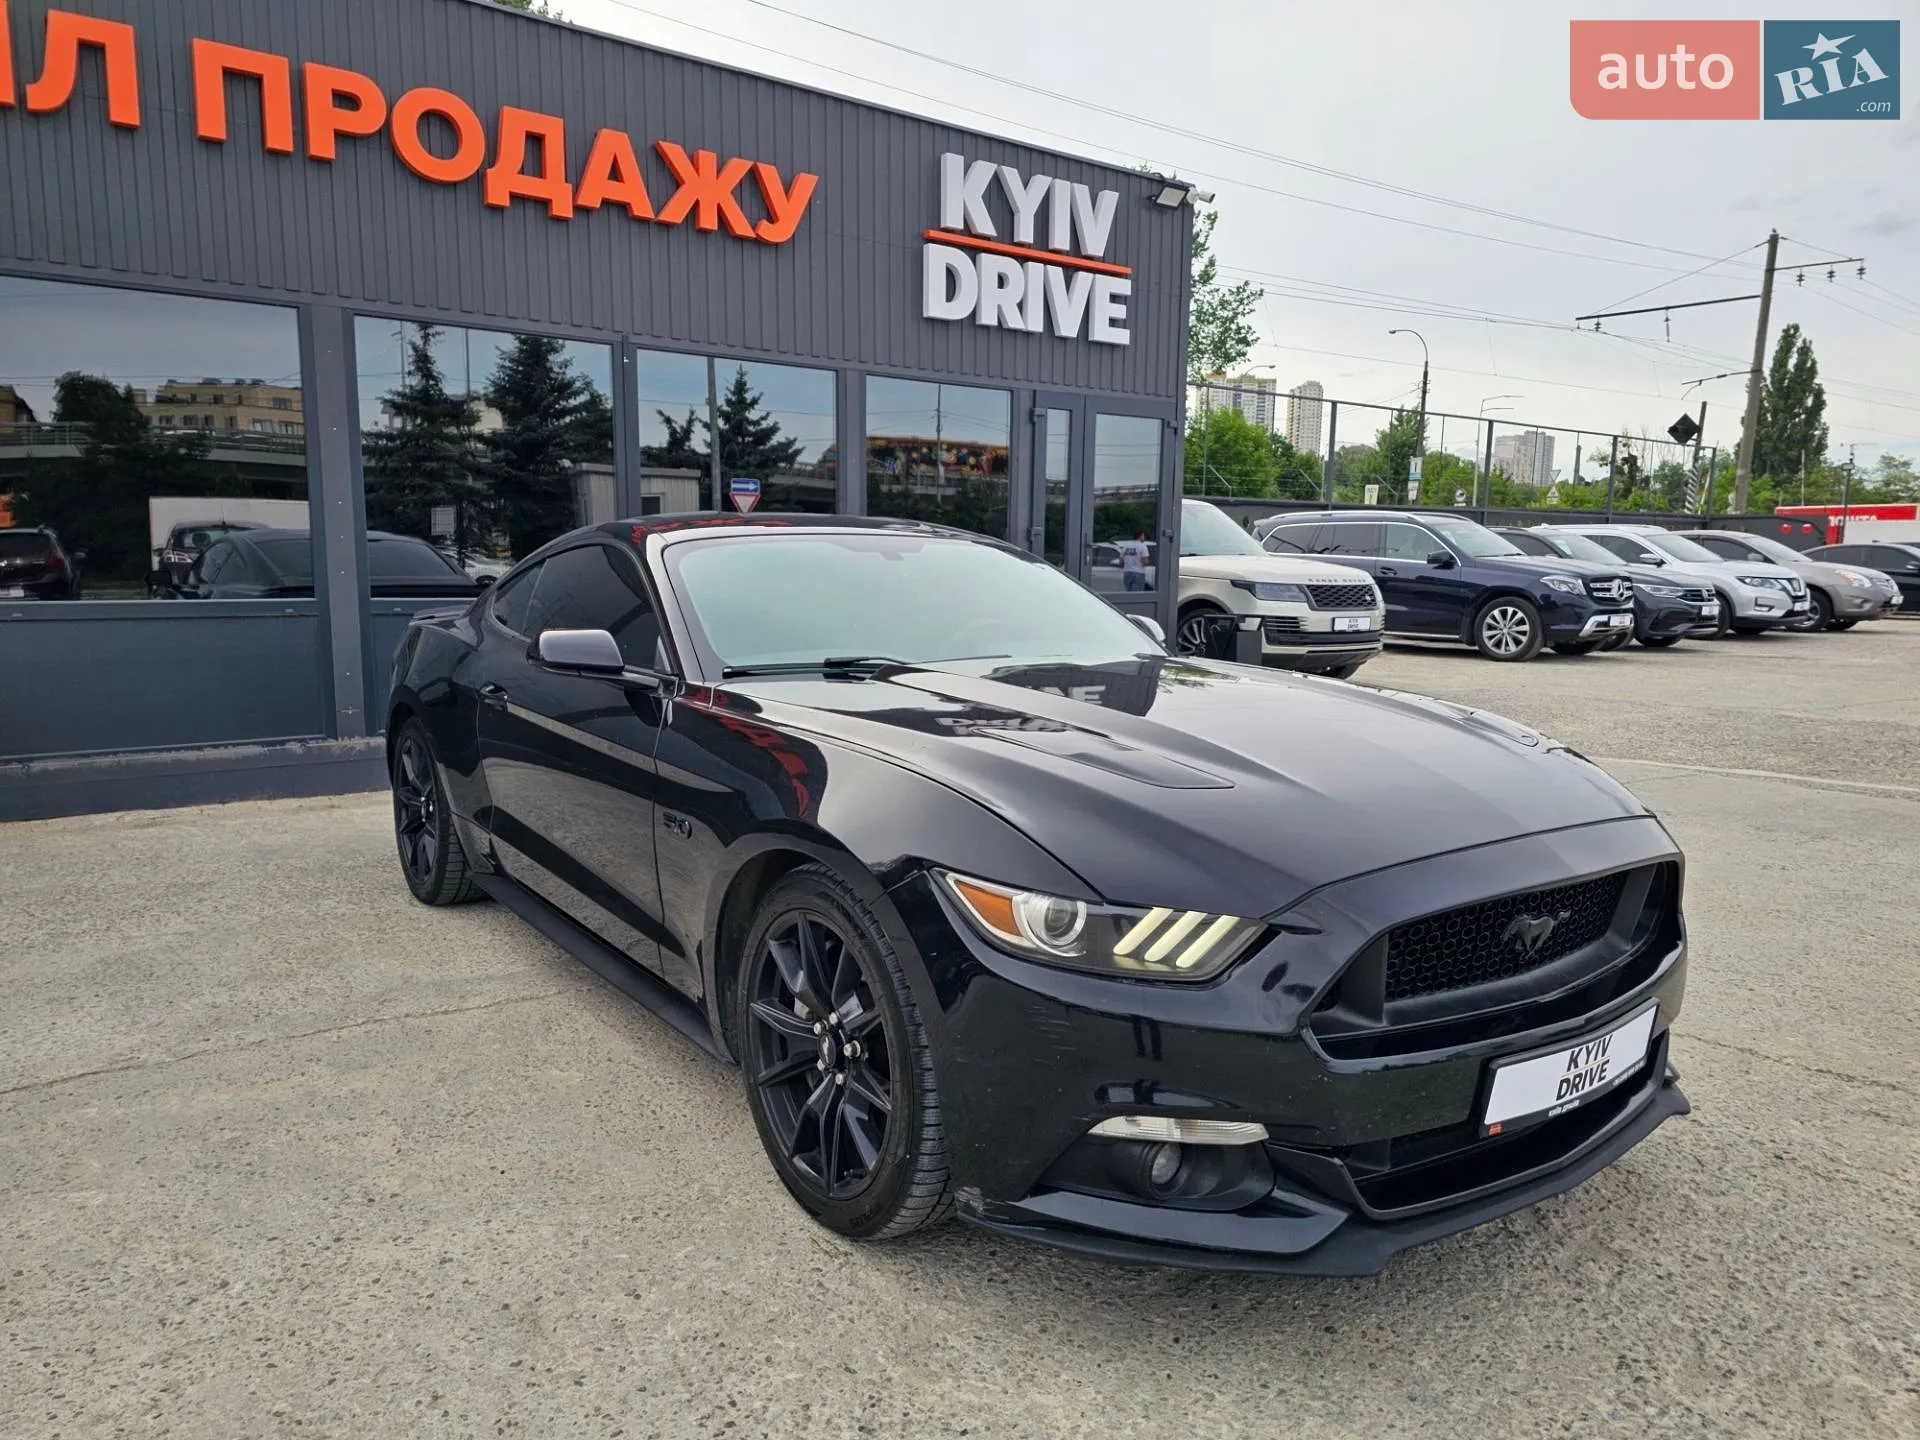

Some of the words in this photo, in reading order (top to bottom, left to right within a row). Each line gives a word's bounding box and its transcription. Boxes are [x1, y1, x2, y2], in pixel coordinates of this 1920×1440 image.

[192, 38, 818, 244] ПРОДАЖУ
[940, 152, 1119, 258] KYIV
[923, 243, 1131, 345] DRIVE
[1556, 1058, 1610, 1101] DRIVE
[1566, 1034, 1613, 1072] KYIV
